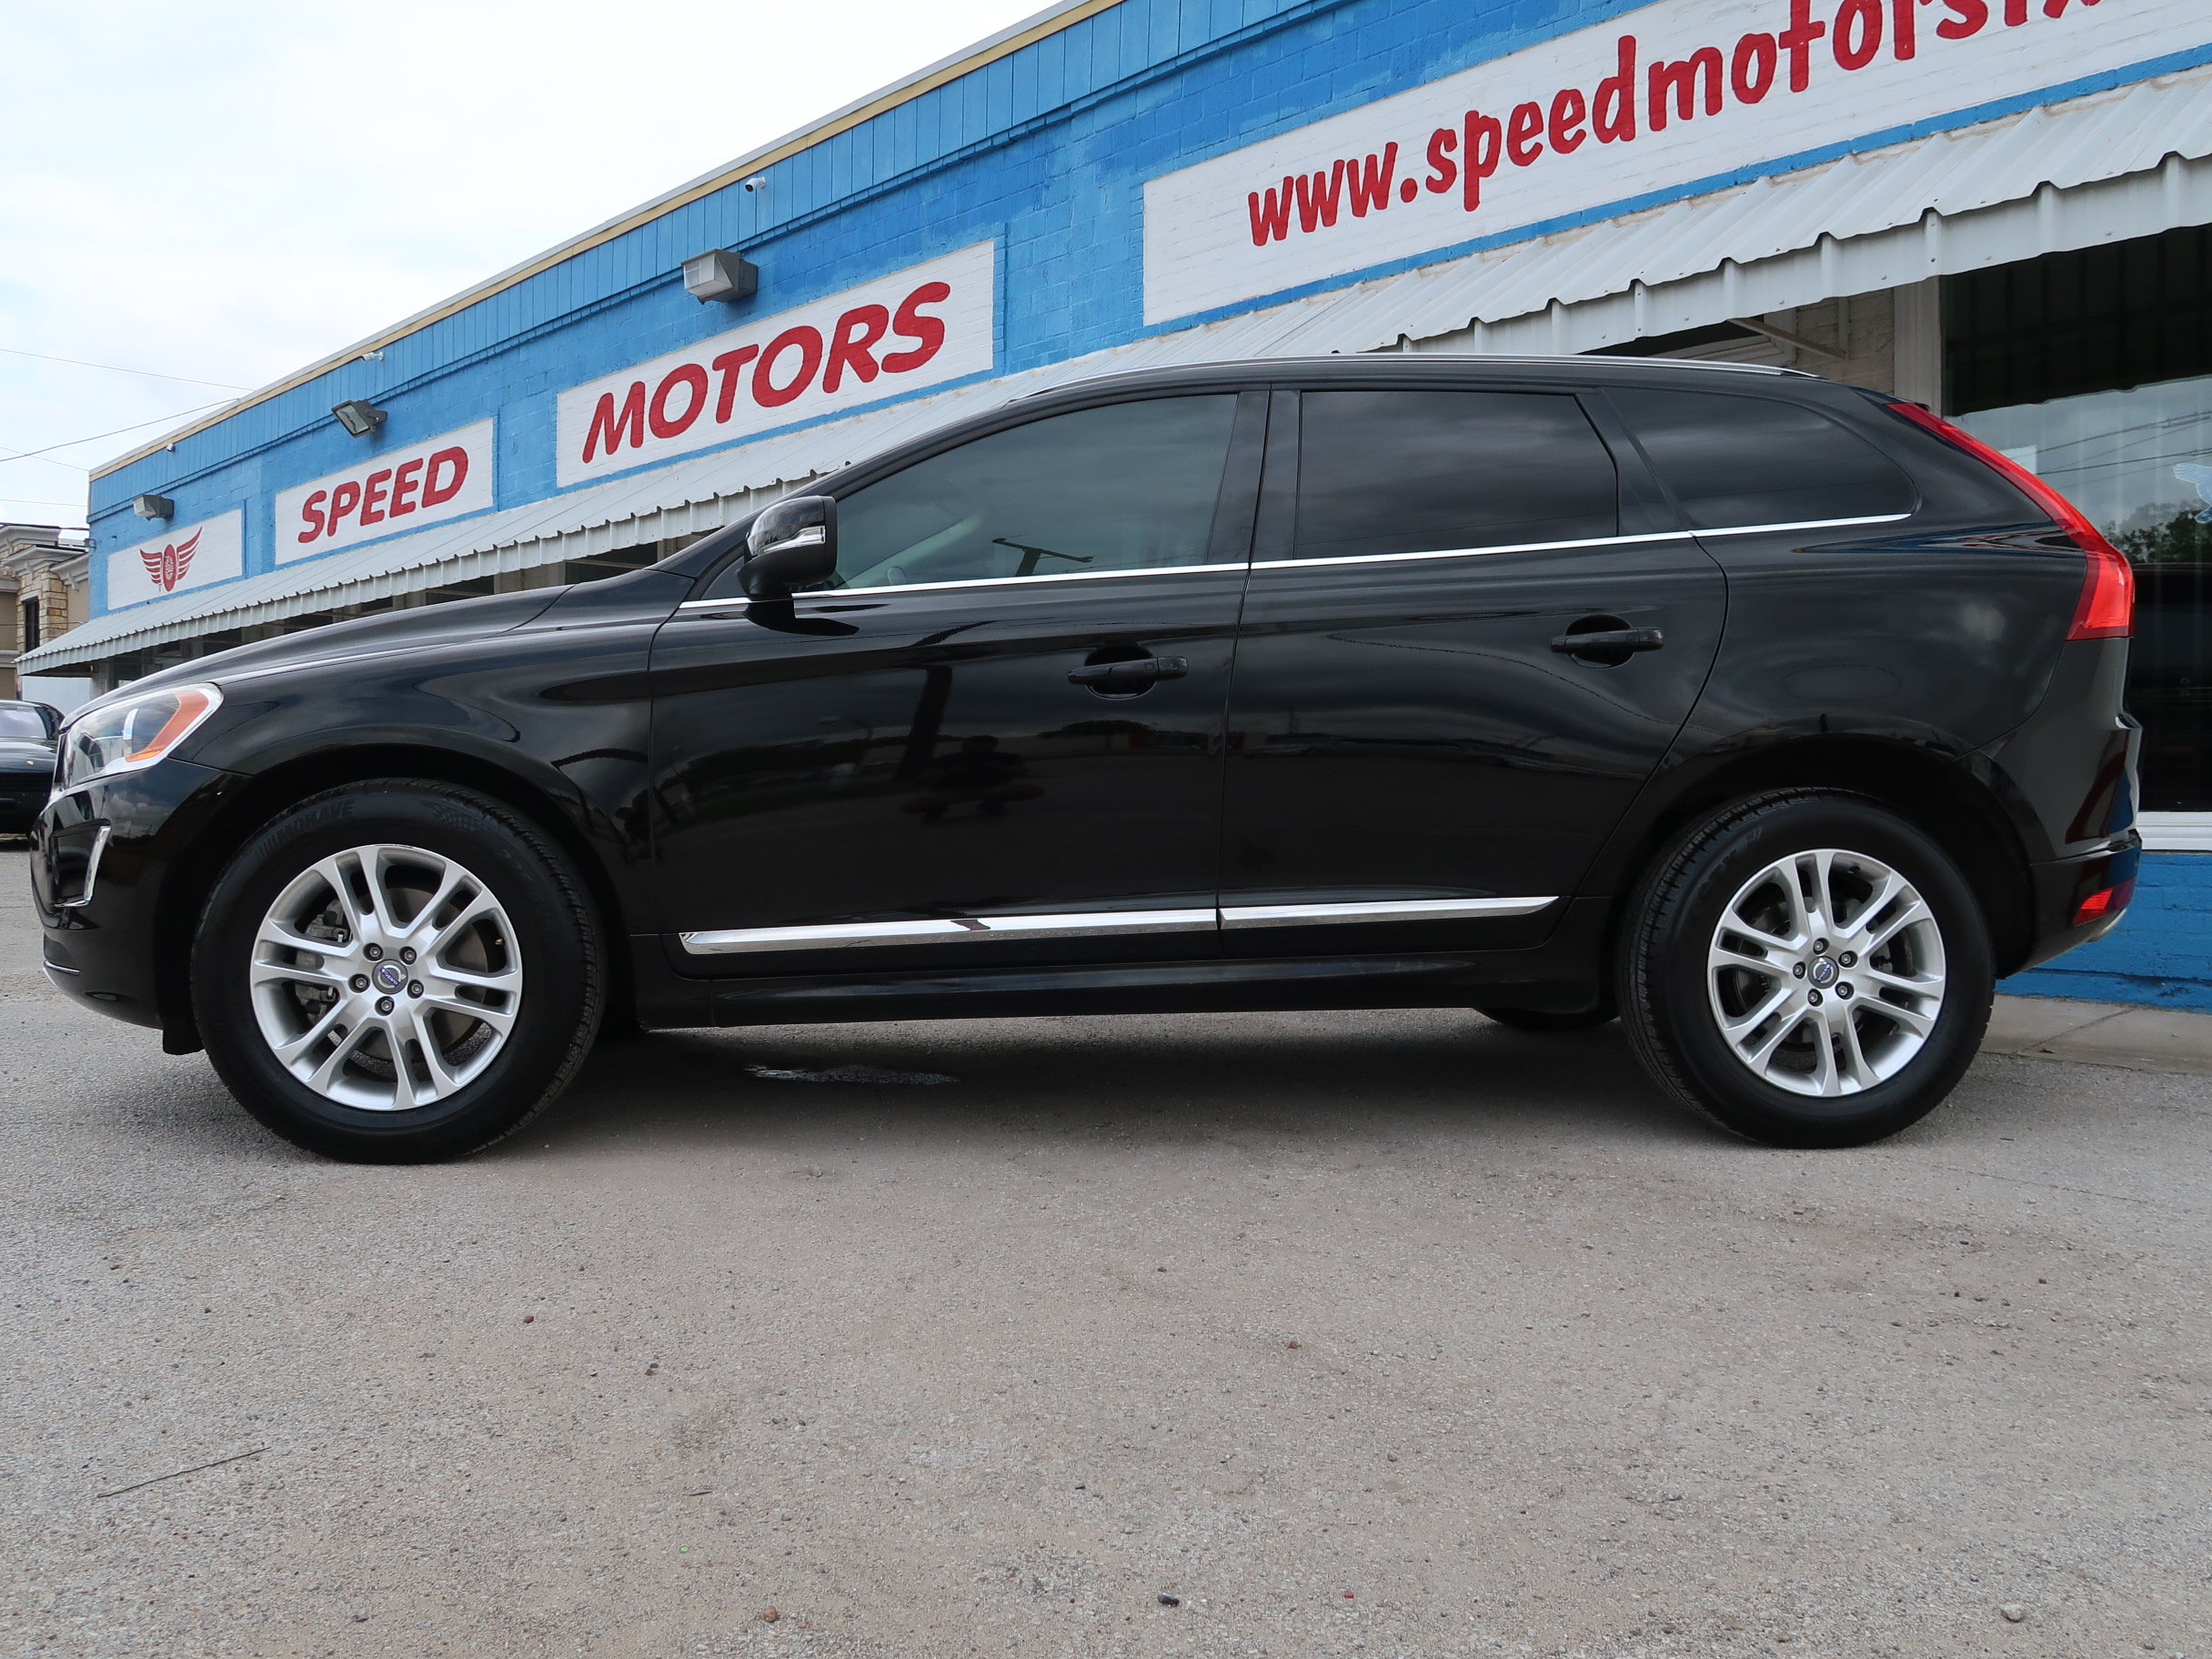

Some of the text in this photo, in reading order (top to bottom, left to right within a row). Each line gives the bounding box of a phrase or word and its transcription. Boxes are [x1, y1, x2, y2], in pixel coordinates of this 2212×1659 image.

[1249, 0, 2102, 246] www.speedmotors
[583, 281, 950, 463] MOTORS
[298, 447, 468, 542] SPEED
